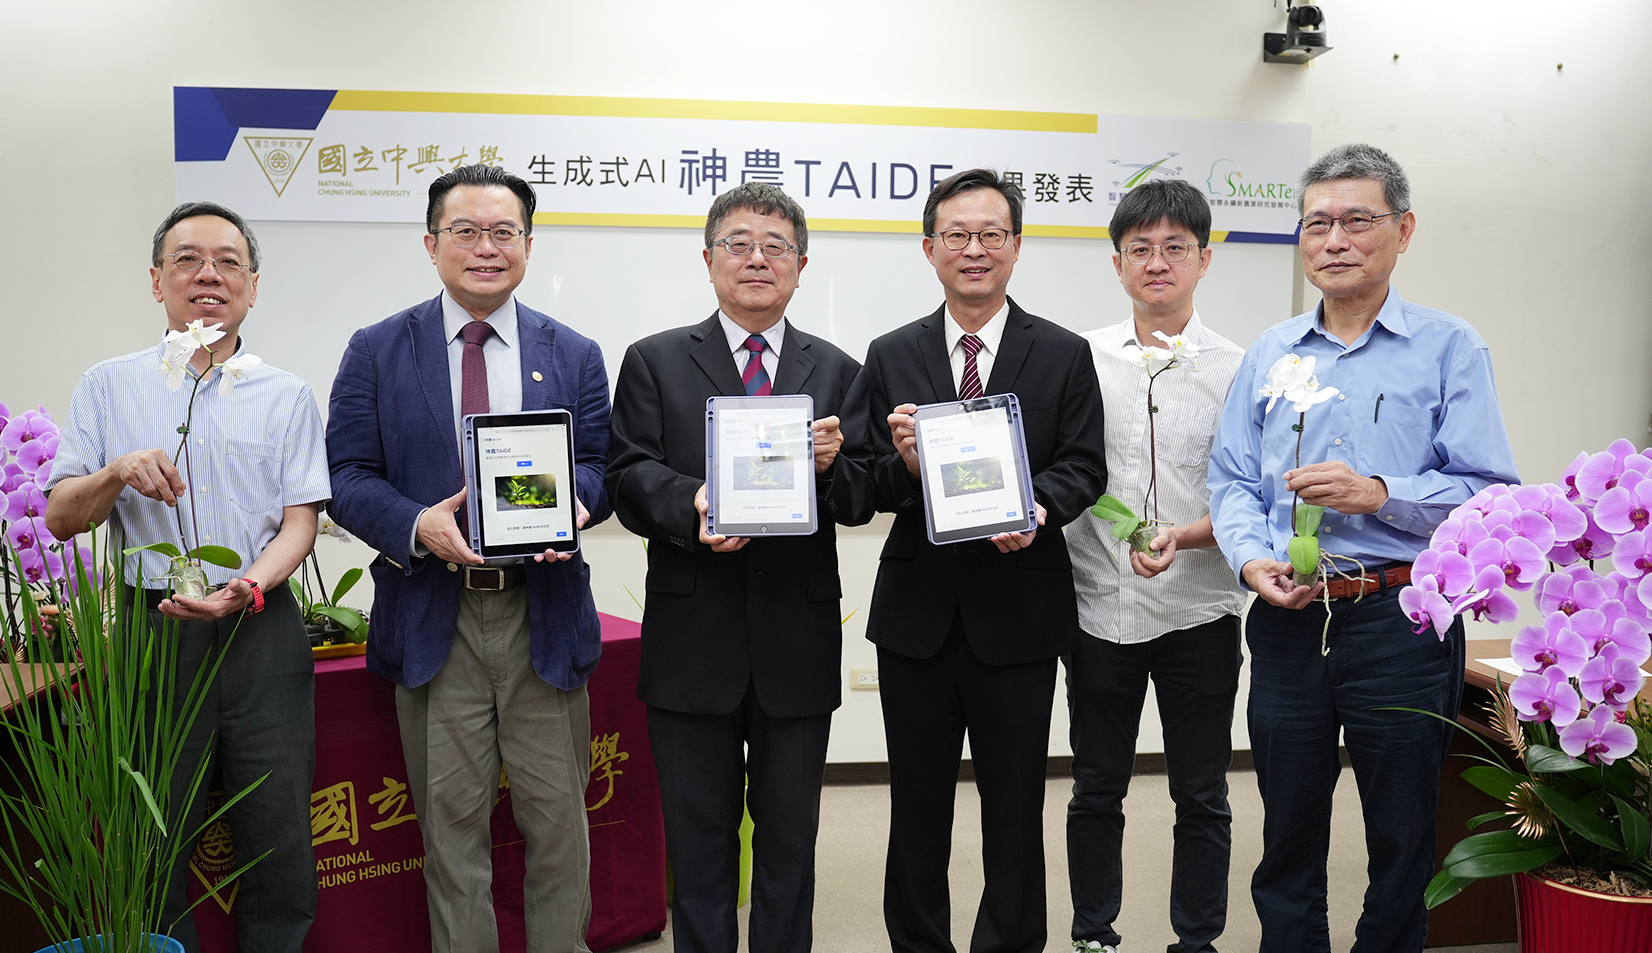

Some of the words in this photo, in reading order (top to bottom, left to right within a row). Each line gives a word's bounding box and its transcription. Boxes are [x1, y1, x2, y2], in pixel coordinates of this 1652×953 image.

[254, 140, 303, 149] 國立中興大學
[527, 154, 665, 187] 生成式AI
[318, 180, 354, 188] NATIONAL
[345, 189, 368, 197] HSING
[316, 850, 375, 872] ATIONAL
[318, 871, 356, 890] HUNG
[359, 862, 401, 880] HSING
